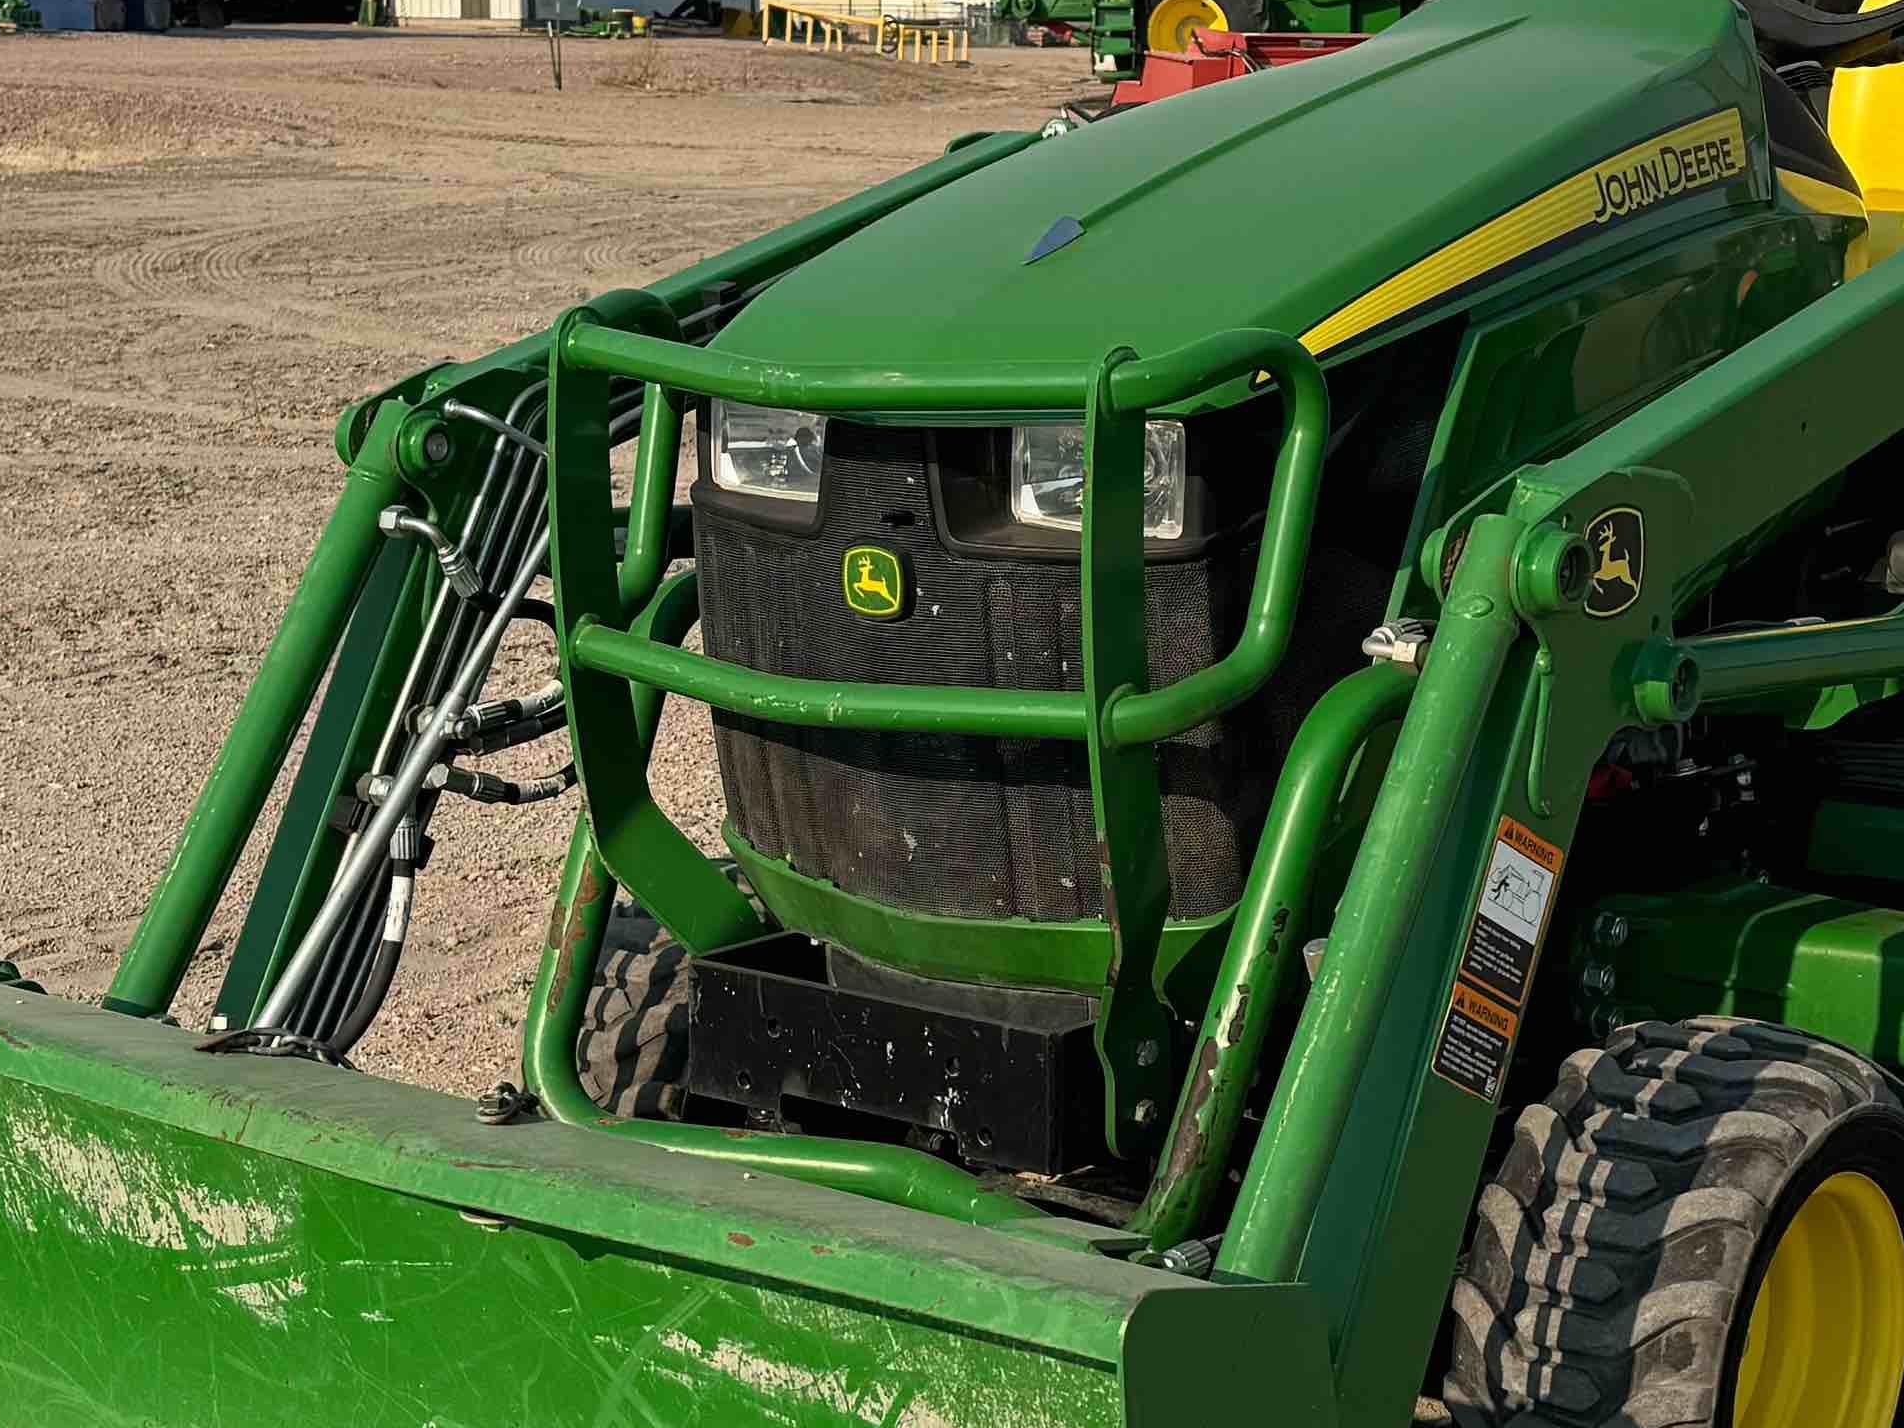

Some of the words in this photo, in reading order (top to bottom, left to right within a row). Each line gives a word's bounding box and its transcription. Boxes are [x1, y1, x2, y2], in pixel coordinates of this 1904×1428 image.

[1594, 159, 1663, 218] JOHN
[1659, 137, 1737, 191] DEERE
[1513, 829, 1553, 865] WARNING
[1469, 1001, 1509, 1031] WARNING
